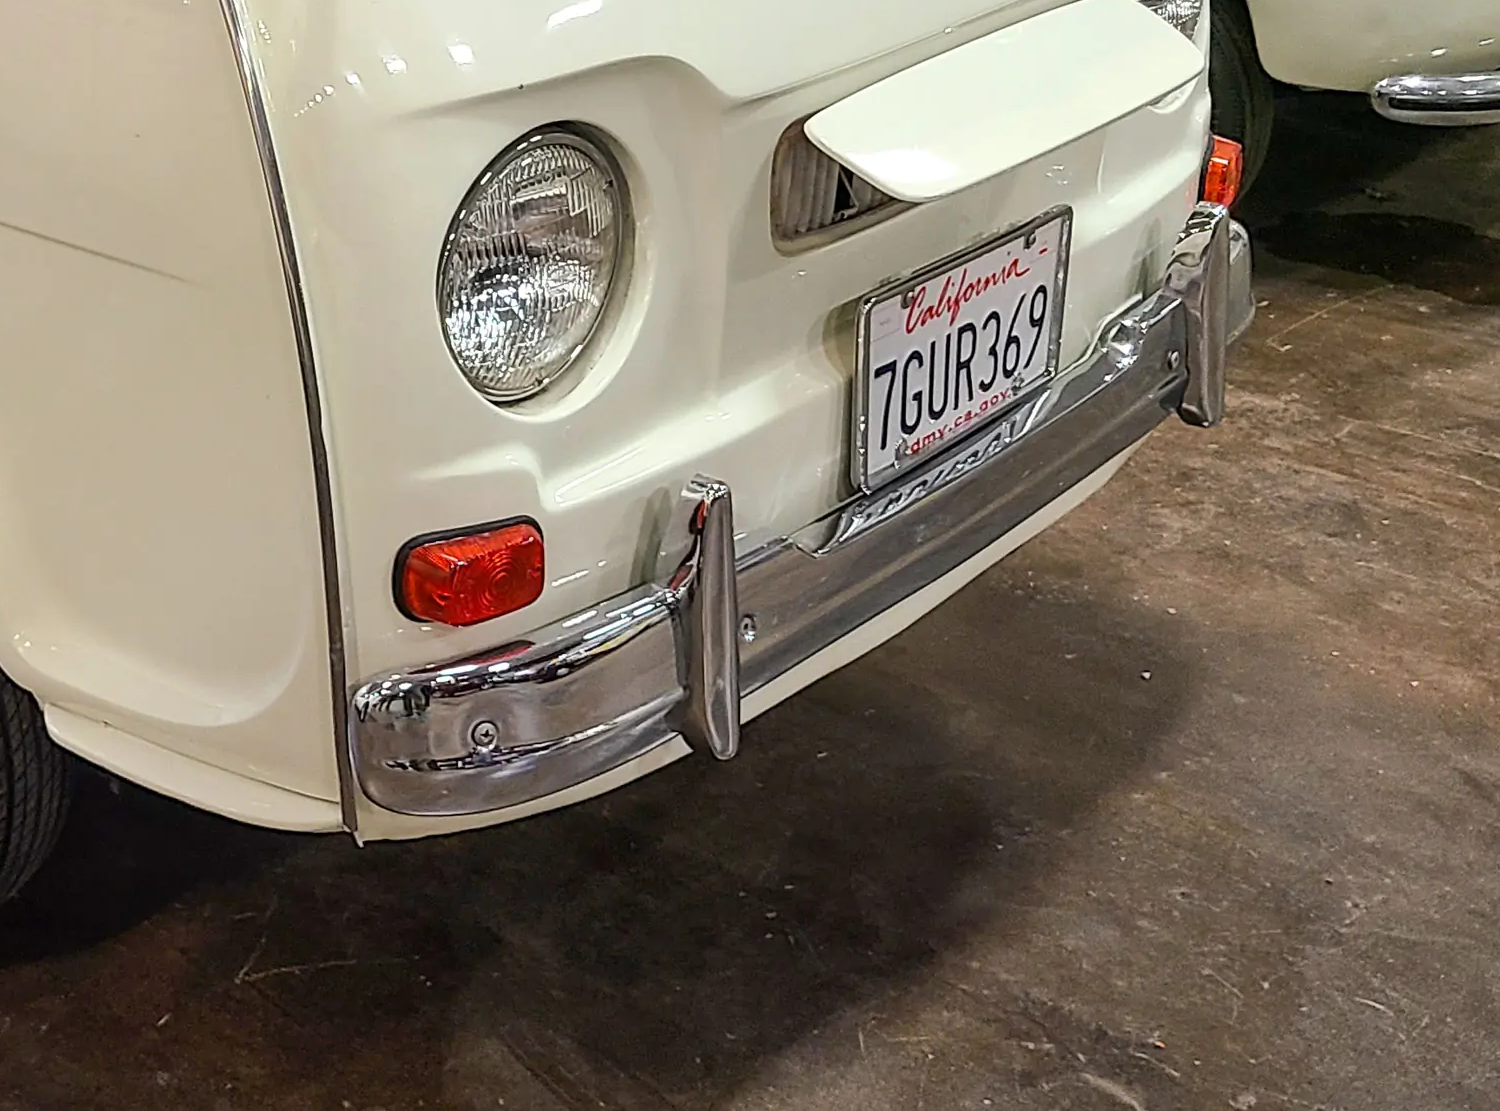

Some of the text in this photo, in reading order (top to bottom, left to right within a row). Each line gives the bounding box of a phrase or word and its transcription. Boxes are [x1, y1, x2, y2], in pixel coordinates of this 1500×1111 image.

[905, 251, 1031, 335] California
[873, 284, 1048, 451] 7GUR369
[909, 388, 1011, 456] dmv.ca.gov
